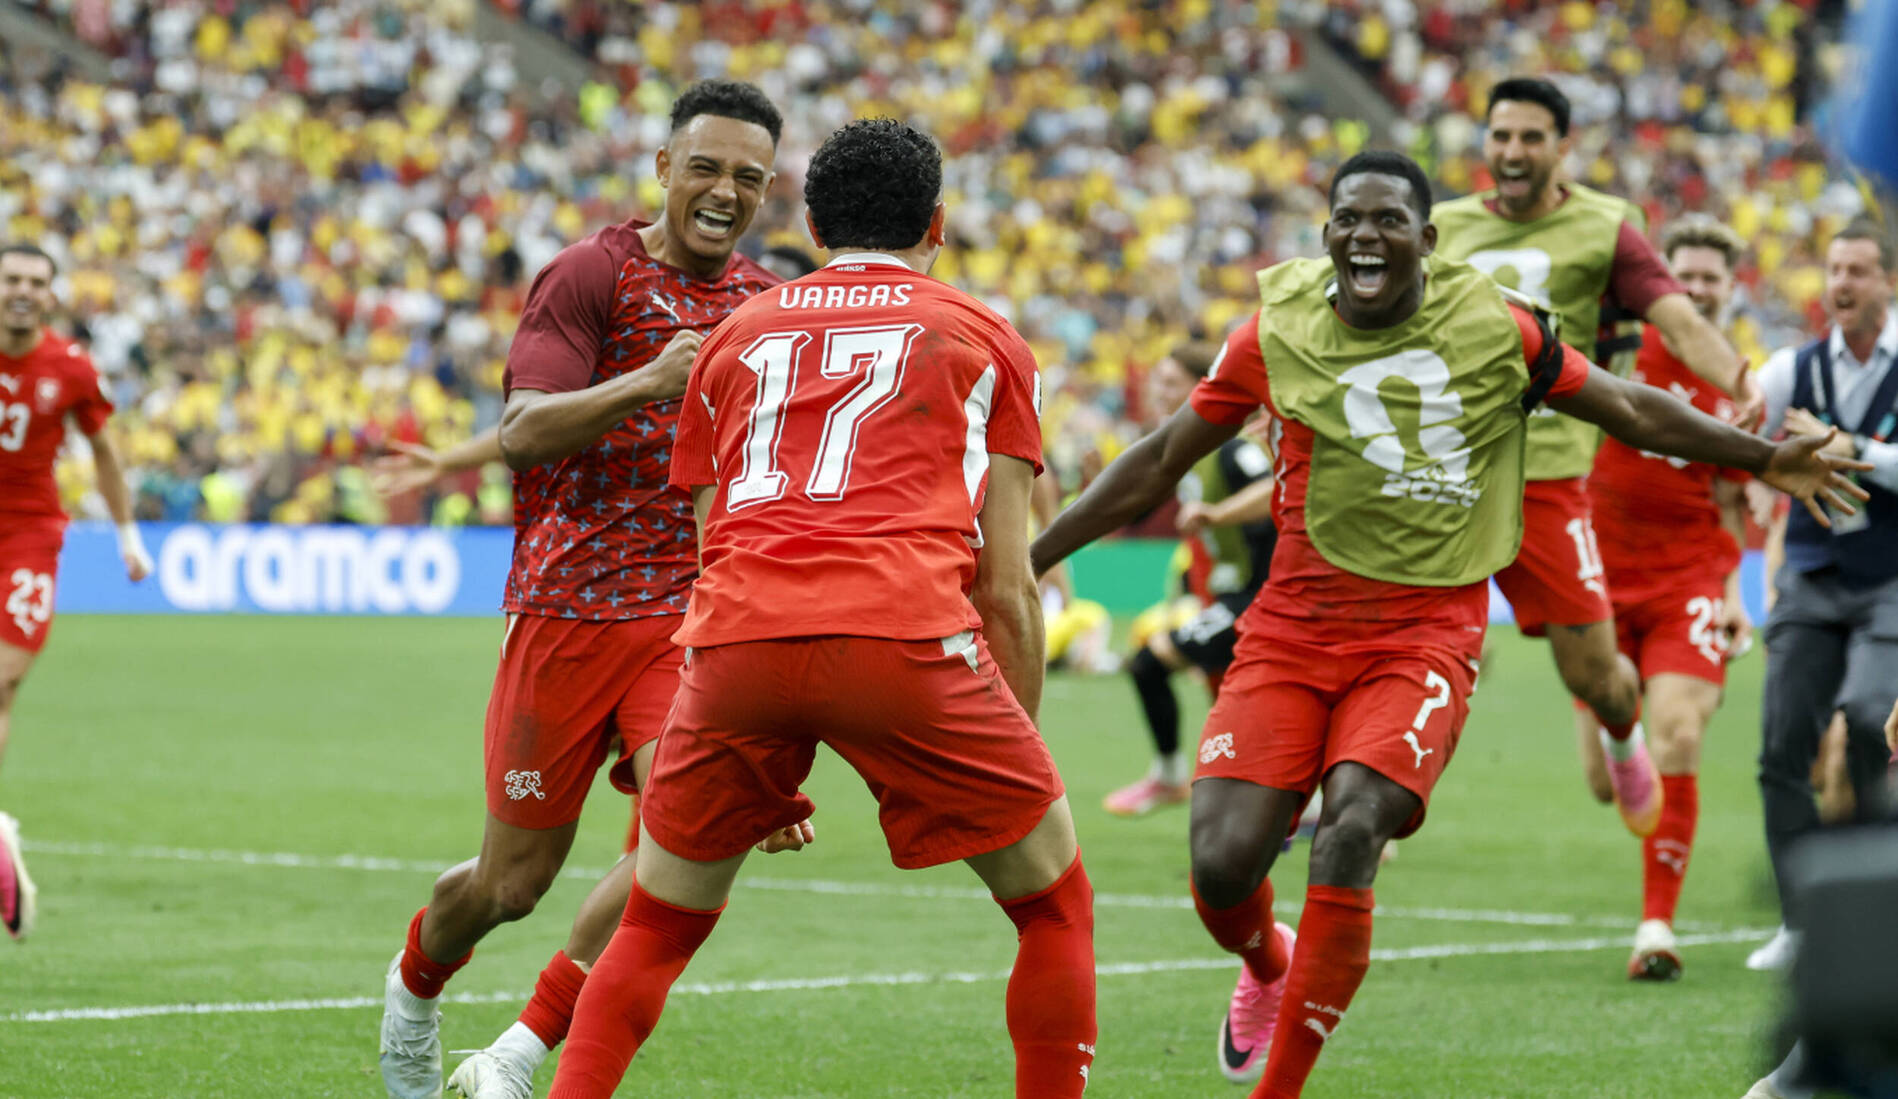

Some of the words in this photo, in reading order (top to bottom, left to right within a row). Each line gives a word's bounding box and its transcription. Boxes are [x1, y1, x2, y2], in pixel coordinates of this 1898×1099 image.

[779, 284, 913, 309] VARGAS
[0, 401, 31, 452] 3
[727, 323, 925, 513] 17
[6, 568, 53, 622] 23
[159, 526, 460, 613] aramco
[1413, 669, 1451, 730] 7
